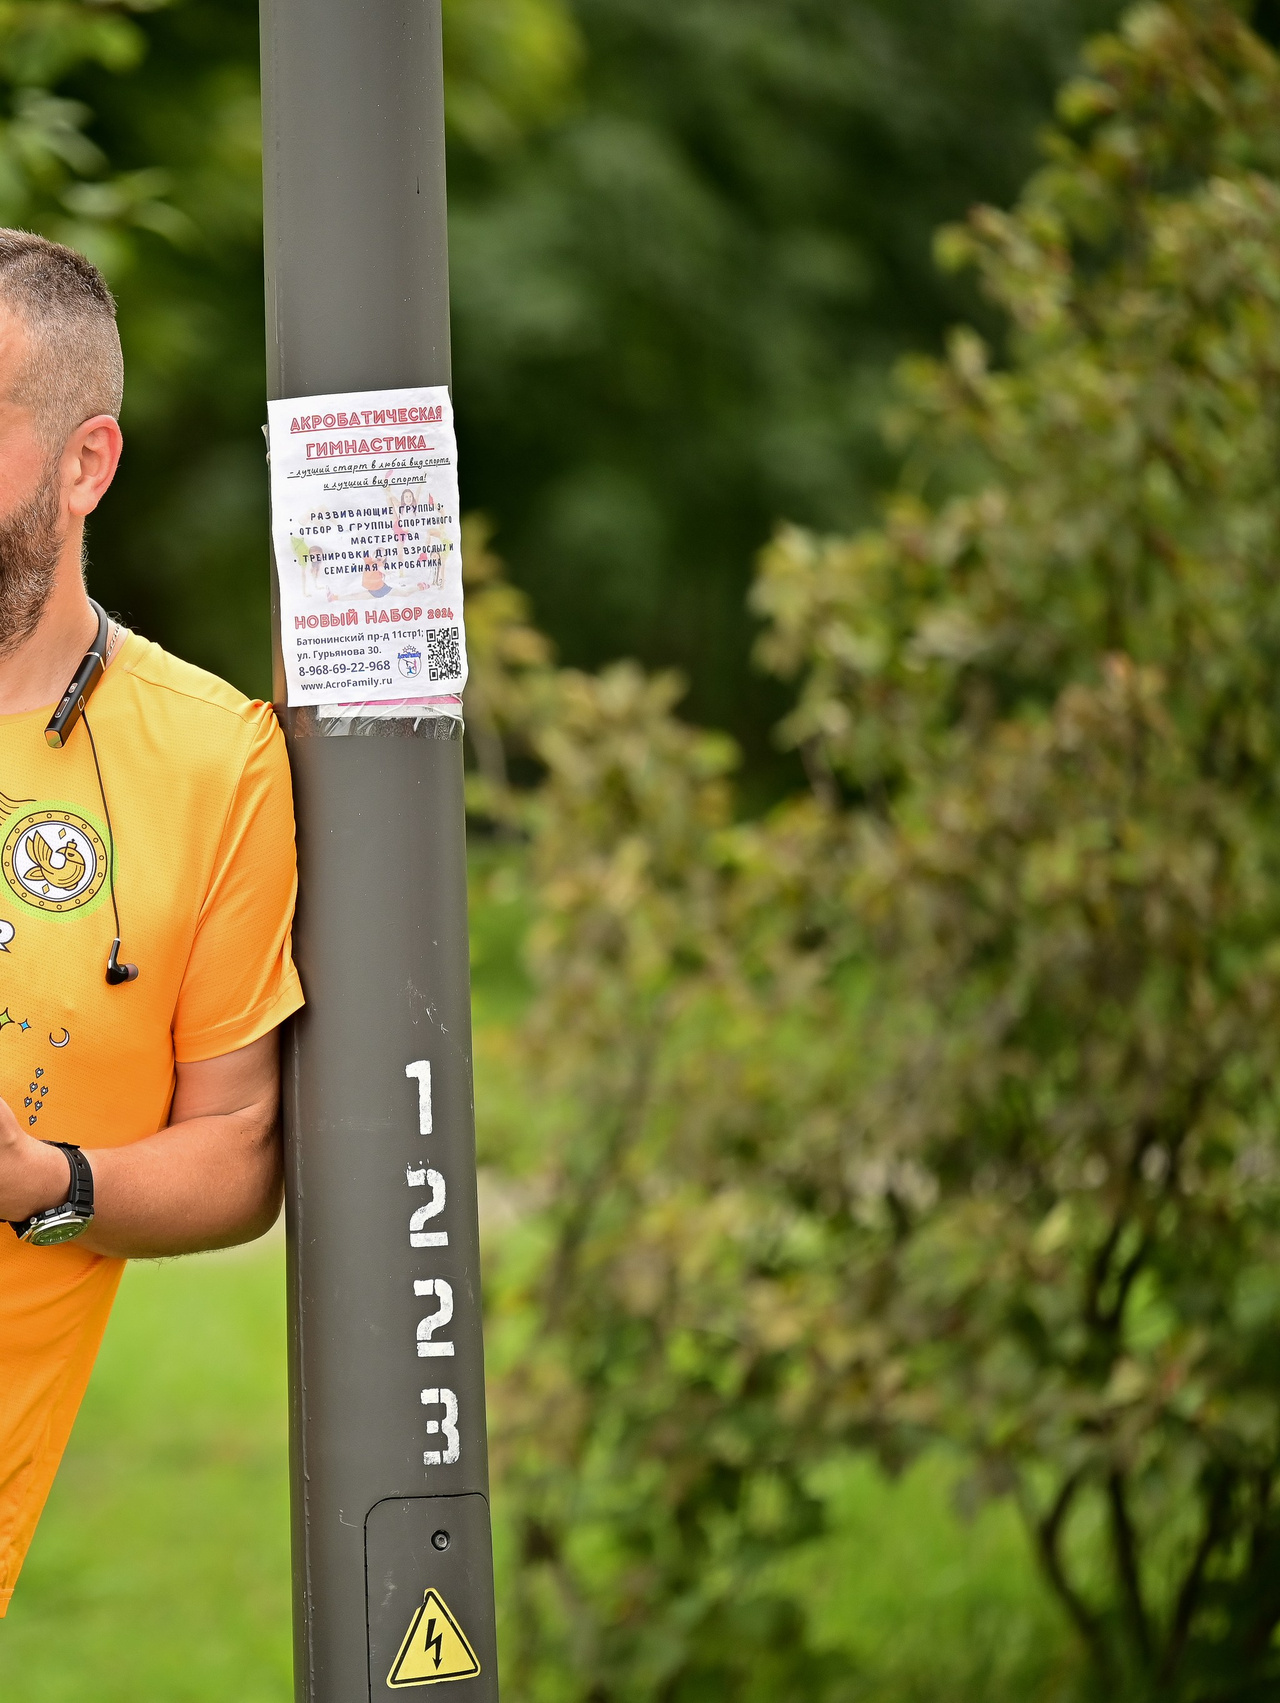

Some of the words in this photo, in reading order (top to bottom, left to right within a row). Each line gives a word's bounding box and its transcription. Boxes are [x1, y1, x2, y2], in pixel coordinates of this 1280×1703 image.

[290, 405, 443, 432] АКРОБАТИЧЕСКАЯ
[306, 435, 427, 458] ГИМНАСТИКА
[296, 465, 331, 478] лучший
[332, 463, 368, 474] старт
[371, 460, 377, 469] в
[378, 458, 407, 469] любой
[409, 457, 424, 469] вид
[331, 477, 369, 491] лучший
[372, 475, 389, 488] вид
[391, 472, 427, 486] спорта!
[310, 506, 394, 521] РАЗВИВАЮЩИЕ
[398, 503, 435, 514] ГРУППЫ
[299, 525, 332, 536] ОТБОР
[337, 525, 344, 533] В
[349, 520, 394, 532] ГРУППЫ
[397, 515, 453, 528] СПОРТИВНОГО
[350, 532, 420, 545] МАСТЕРСТВА
[302, 549, 370, 563] ТРЕНИРОВКИ
[374, 547, 398, 559] ДЛЯ
[403, 543, 446, 555] ВЗРОСЛЫХ
[324, 562, 378, 575] СЕМЕЙНАЯ
[384, 558, 442, 571] АКРОБАТИКА
[294, 608, 359, 630] НОВЫЙ
[365, 606, 423, 624] НАБОР
[296, 632, 365, 646] Батюнинский
[367, 633, 390, 642] пр-д
[297, 652, 311, 662] ул.
[313, 648, 365, 661] Гурьянова
[367, 645, 382, 655] 30.
[298, 660, 391, 677] 8-968-69-22-968
[300, 676, 393, 691] www.AcroFamily.ru
